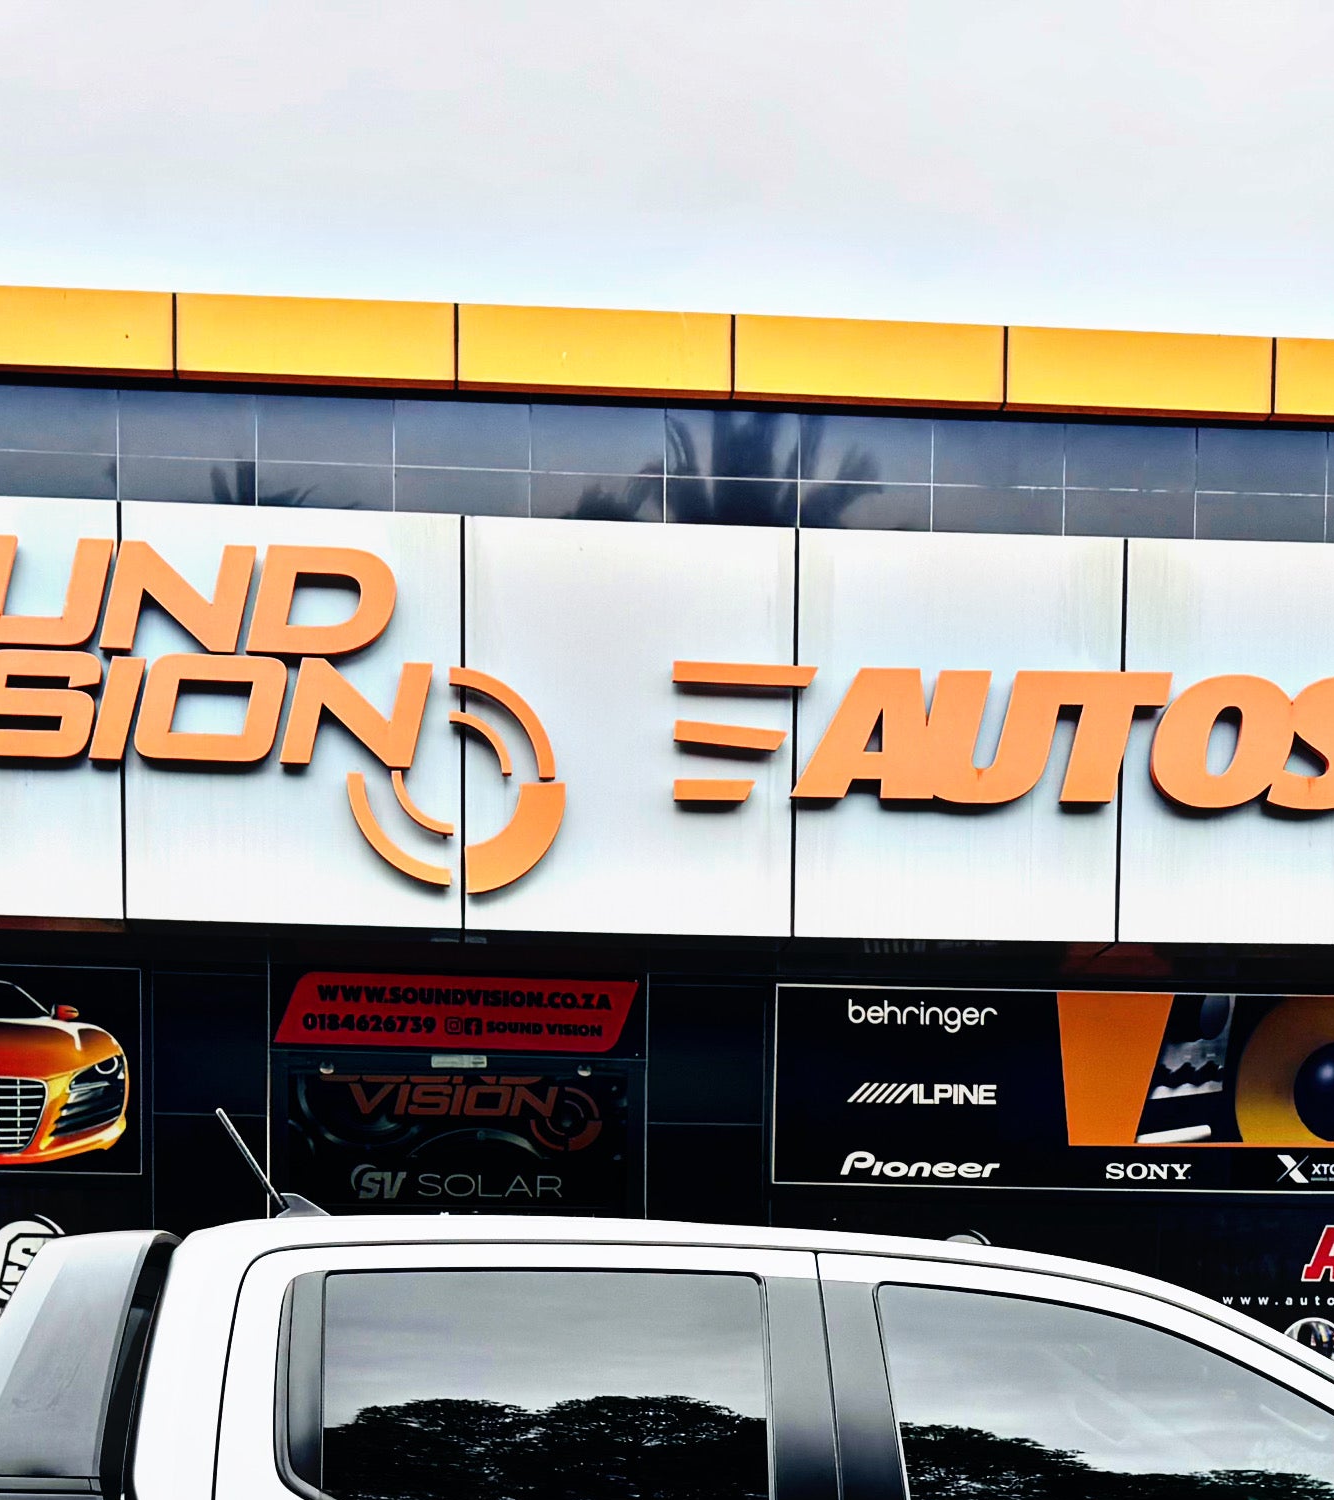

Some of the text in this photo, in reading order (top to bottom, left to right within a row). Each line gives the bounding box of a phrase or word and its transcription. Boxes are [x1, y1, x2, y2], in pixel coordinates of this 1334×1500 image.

[317, 985, 612, 1010] WWW.SOUNDVISION.CO.ZA
[486, 1020, 543, 1035] SOUND
[547, 1023, 603, 1037] VISION
[848, 999, 997, 1033] behringer
[349, 1083, 558, 1117] VISION
[885, 1083, 997, 1105] ALPINE
[840, 1151, 1000, 1179] Pioneer
[1105, 1162, 1190, 1180] SONY
[359, 1171, 562, 1199] SV SOLAR
